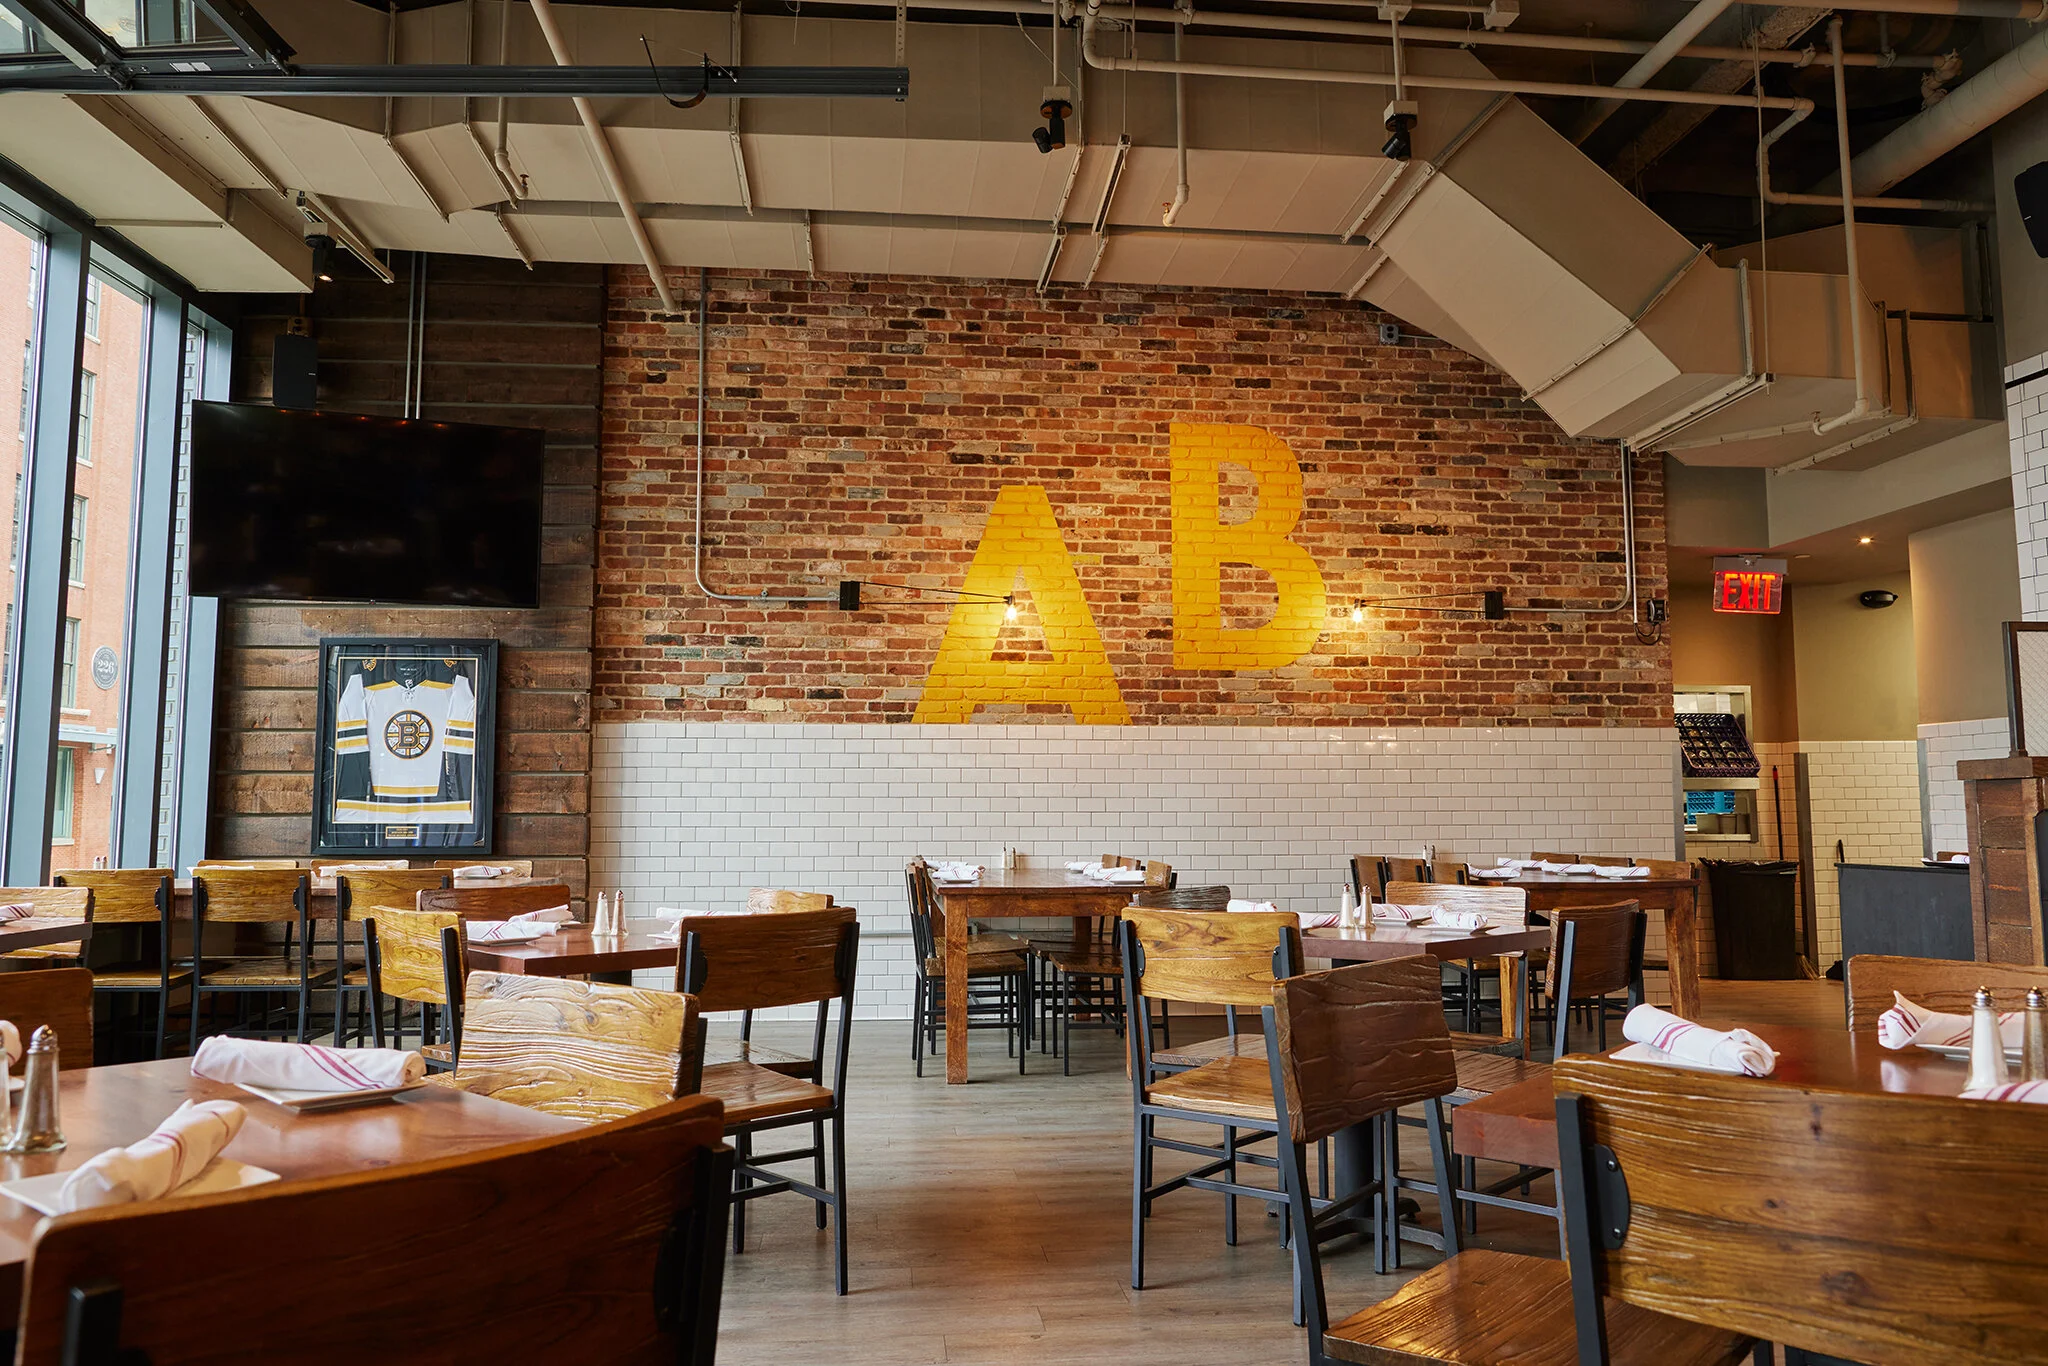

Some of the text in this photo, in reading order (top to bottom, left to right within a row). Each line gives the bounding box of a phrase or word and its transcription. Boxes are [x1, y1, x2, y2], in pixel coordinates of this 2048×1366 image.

[1722, 573, 1776, 610] EXIT
[97, 660, 114, 674] 226
[398, 721, 420, 749] B
